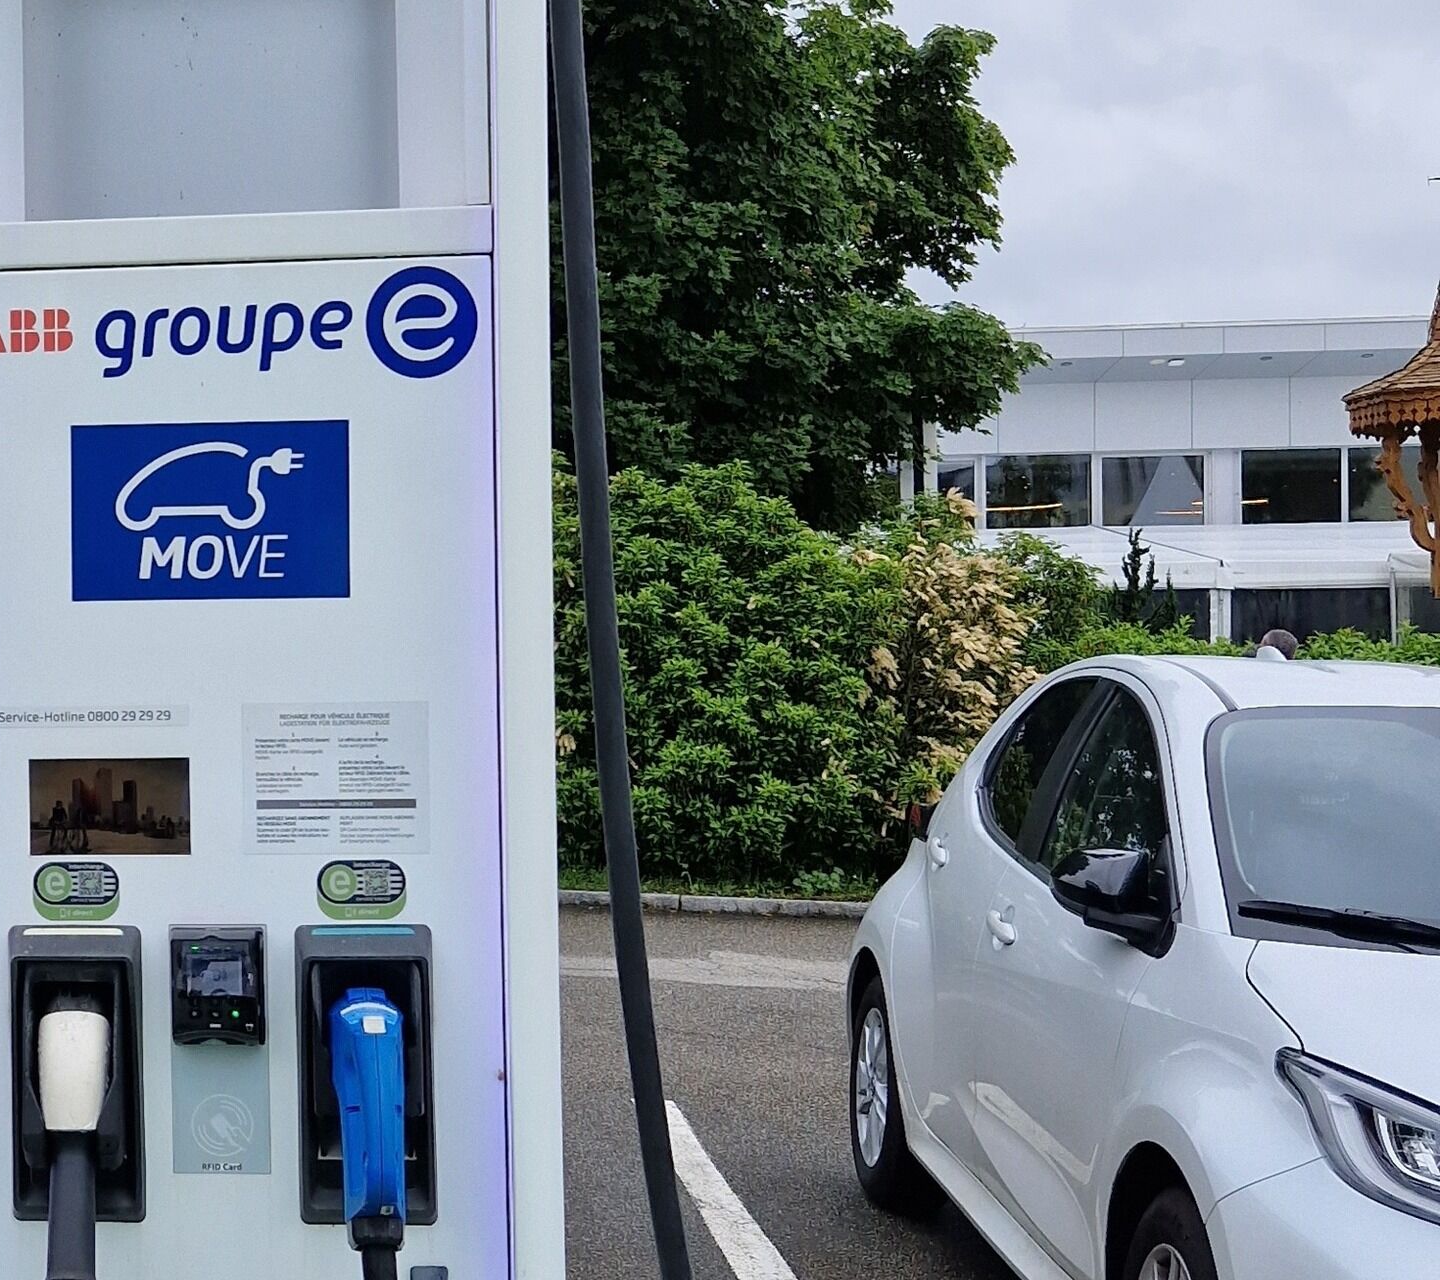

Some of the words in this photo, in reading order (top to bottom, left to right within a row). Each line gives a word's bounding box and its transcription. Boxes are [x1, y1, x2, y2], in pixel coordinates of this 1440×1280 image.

[95, 300, 353, 378] groupe
[138, 534, 289, 579] MOVE
[87, 710, 119, 722] 0800
[121, 710, 136, 721] 29
[138, 710, 154, 721] 29
[156, 710, 171, 721] 29
[44, 871, 66, 896] e
[329, 870, 351, 895] e
[201, 1163, 221, 1171] RFID
[222, 1163, 243, 1171] Card
